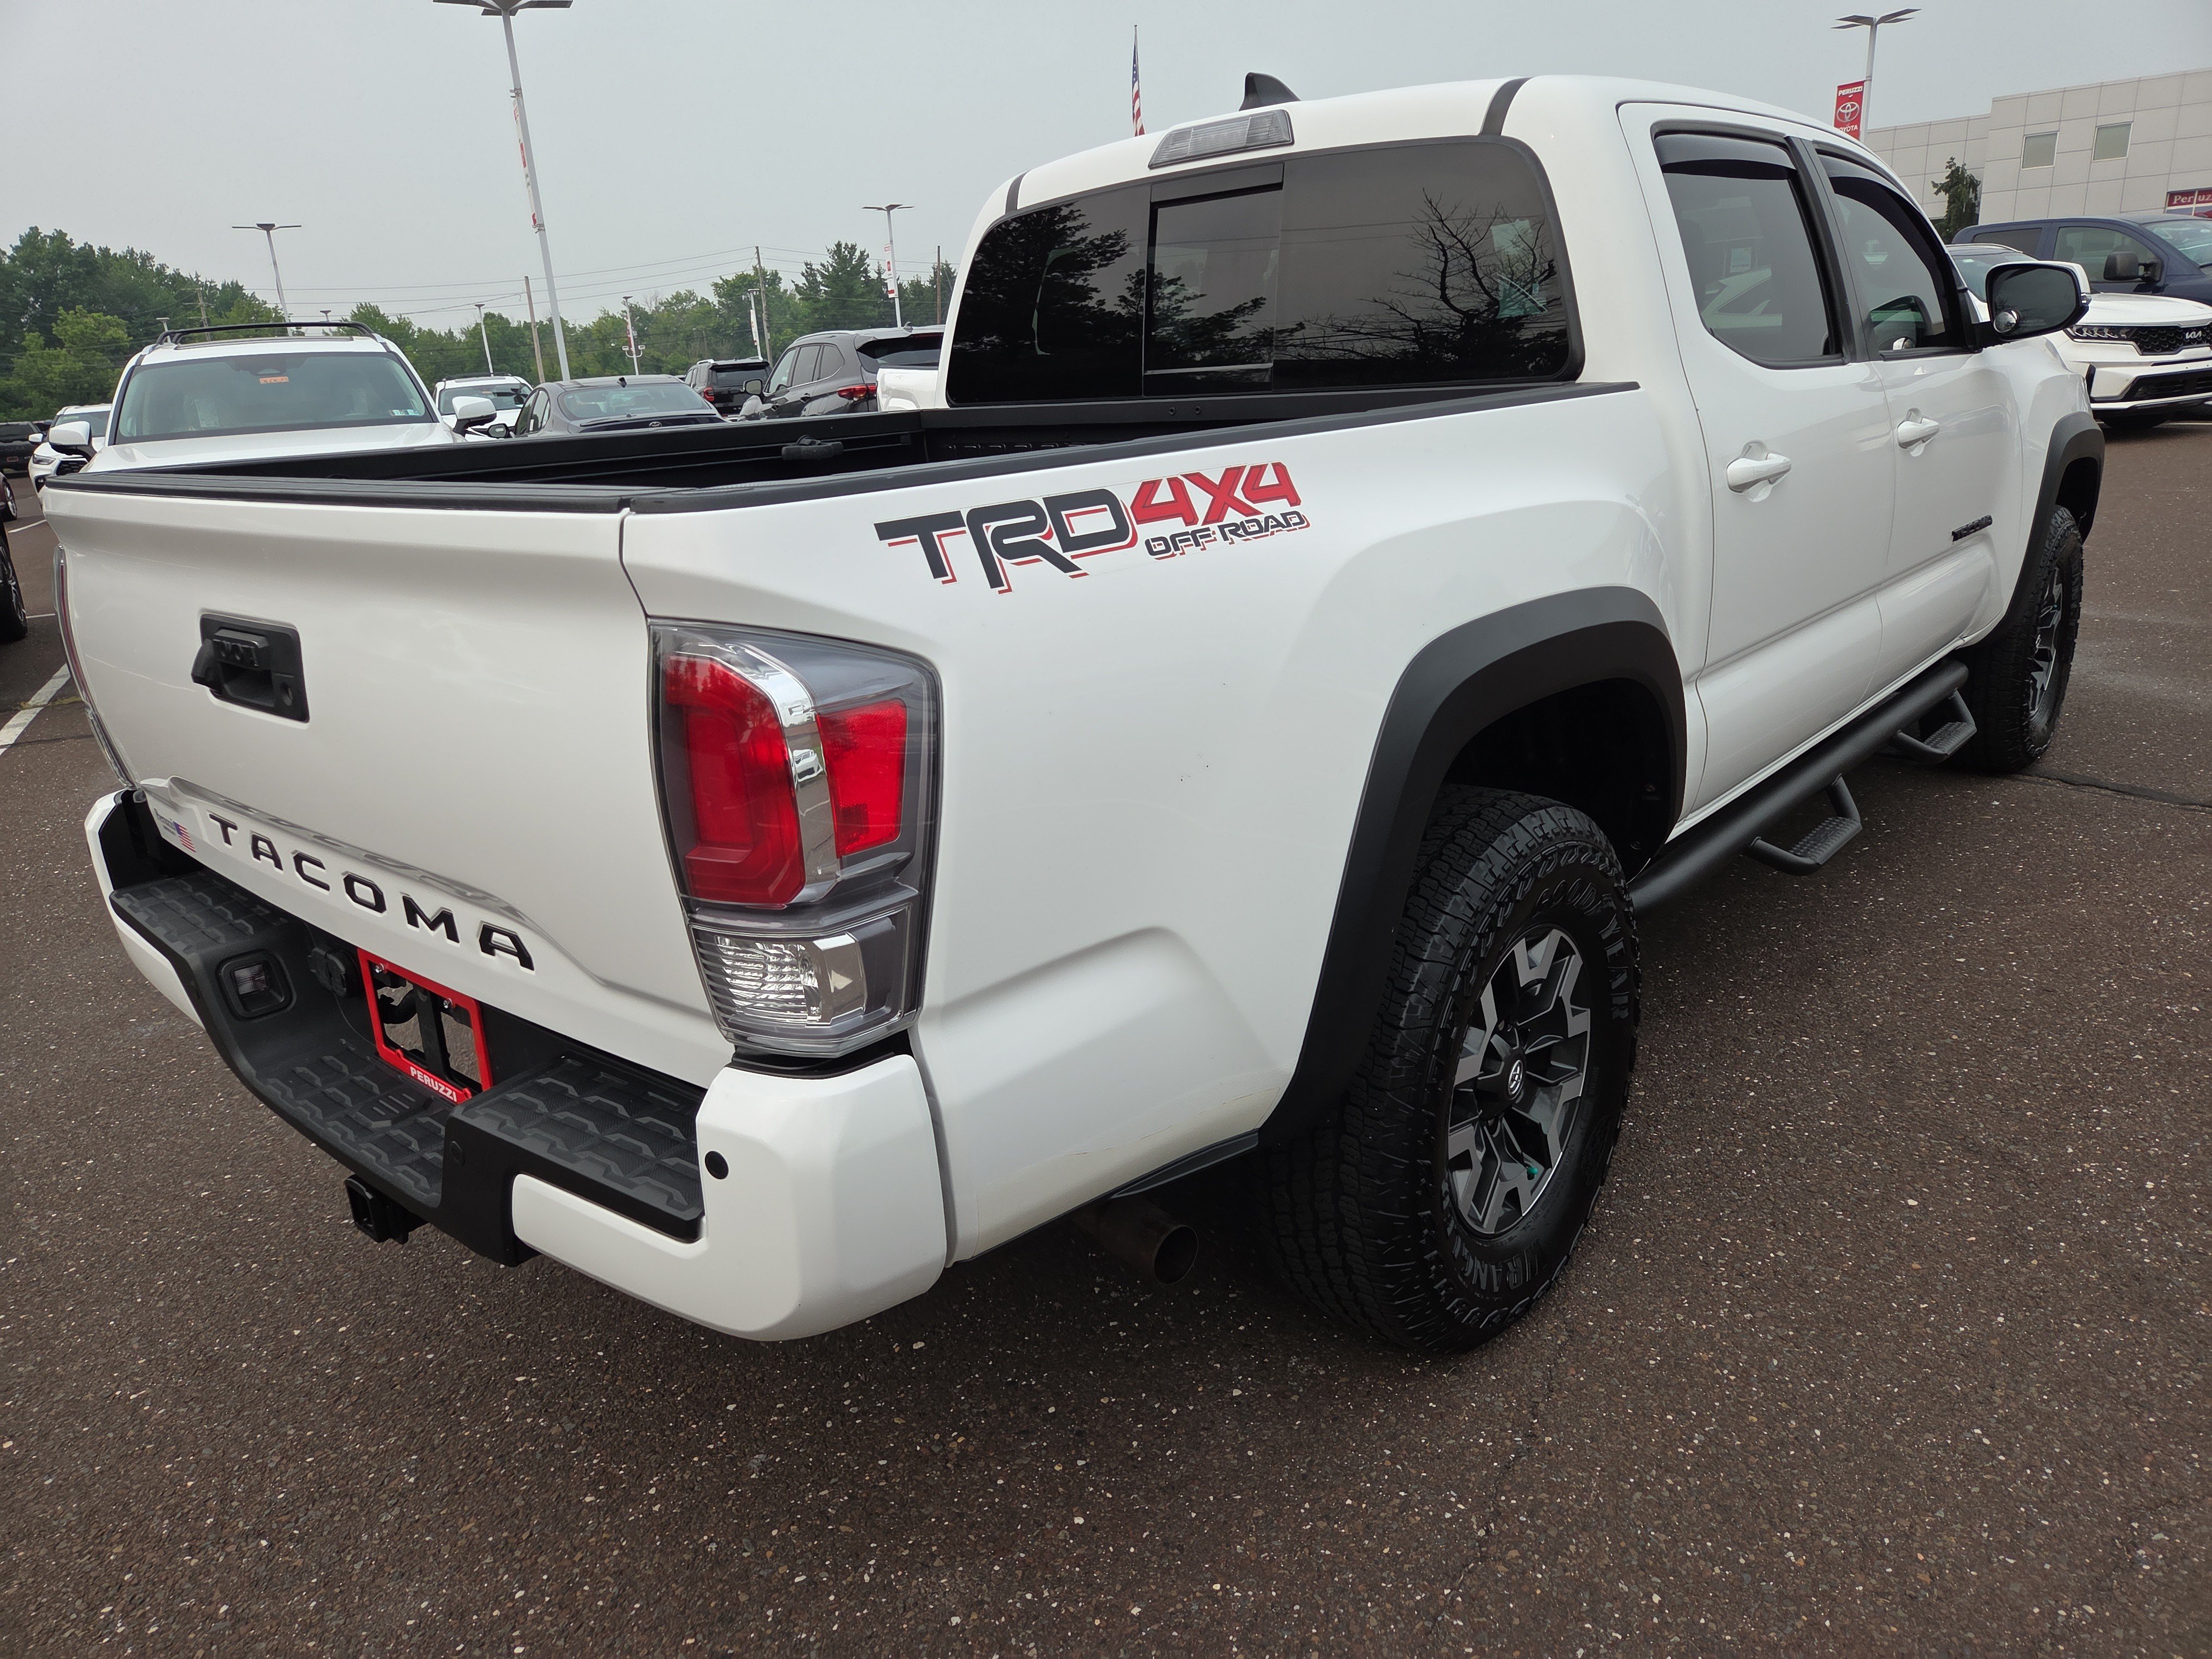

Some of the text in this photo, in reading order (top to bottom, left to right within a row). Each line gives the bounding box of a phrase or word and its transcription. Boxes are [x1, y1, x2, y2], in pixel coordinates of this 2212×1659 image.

[1838, 86, 1863, 97] PERUZZI
[874, 461, 1302, 595] TRD 4X4
[1144, 510, 1311, 560] OFF ROAD
[209, 813, 535, 972] TACOMA
[410, 1066, 457, 1102] PERUZZI
